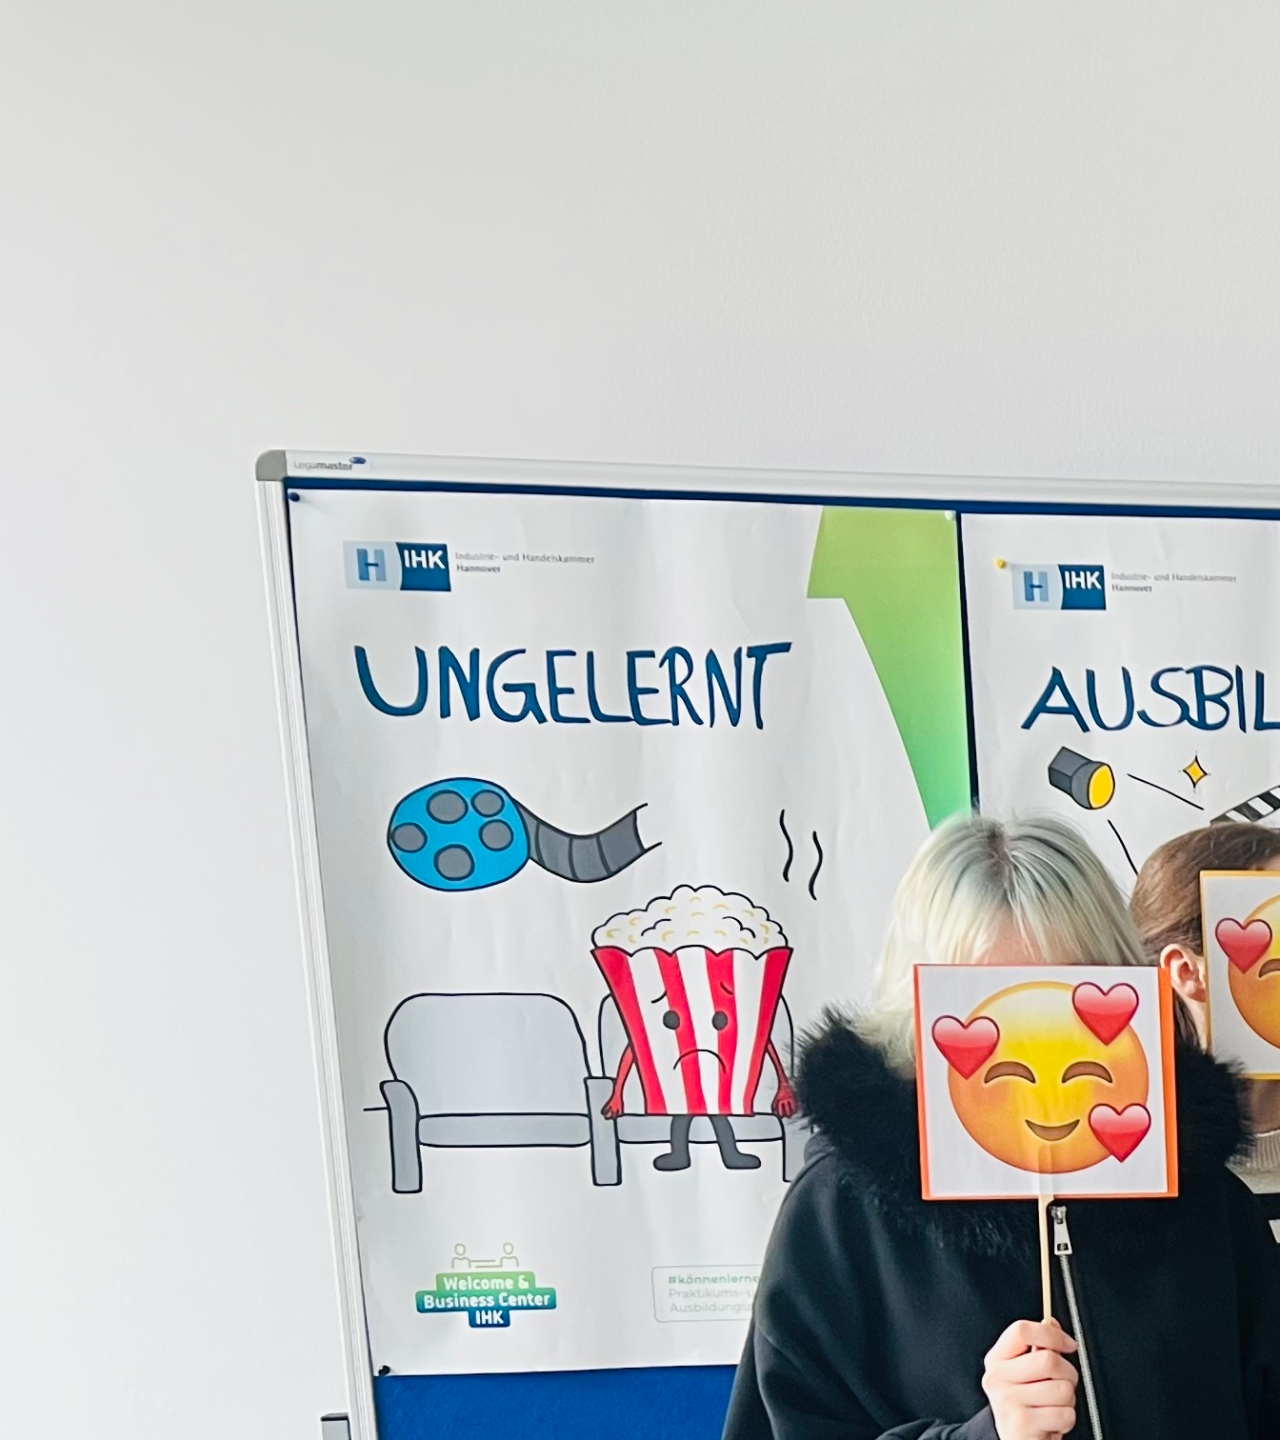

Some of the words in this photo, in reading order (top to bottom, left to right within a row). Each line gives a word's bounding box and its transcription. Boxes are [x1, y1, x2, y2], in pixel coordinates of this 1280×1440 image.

[403, 549, 446, 570] IHK
[503, 552, 520, 562] und
[1064, 570, 1102, 590] IHK
[353, 641, 793, 730] UNGELERNT
[443, 1275, 514, 1291] Welcome
[517, 1274, 530, 1289] &
[423, 1294, 495, 1310] Business
[498, 1292, 550, 1307] Center
[475, 1309, 504, 1325] IHK
